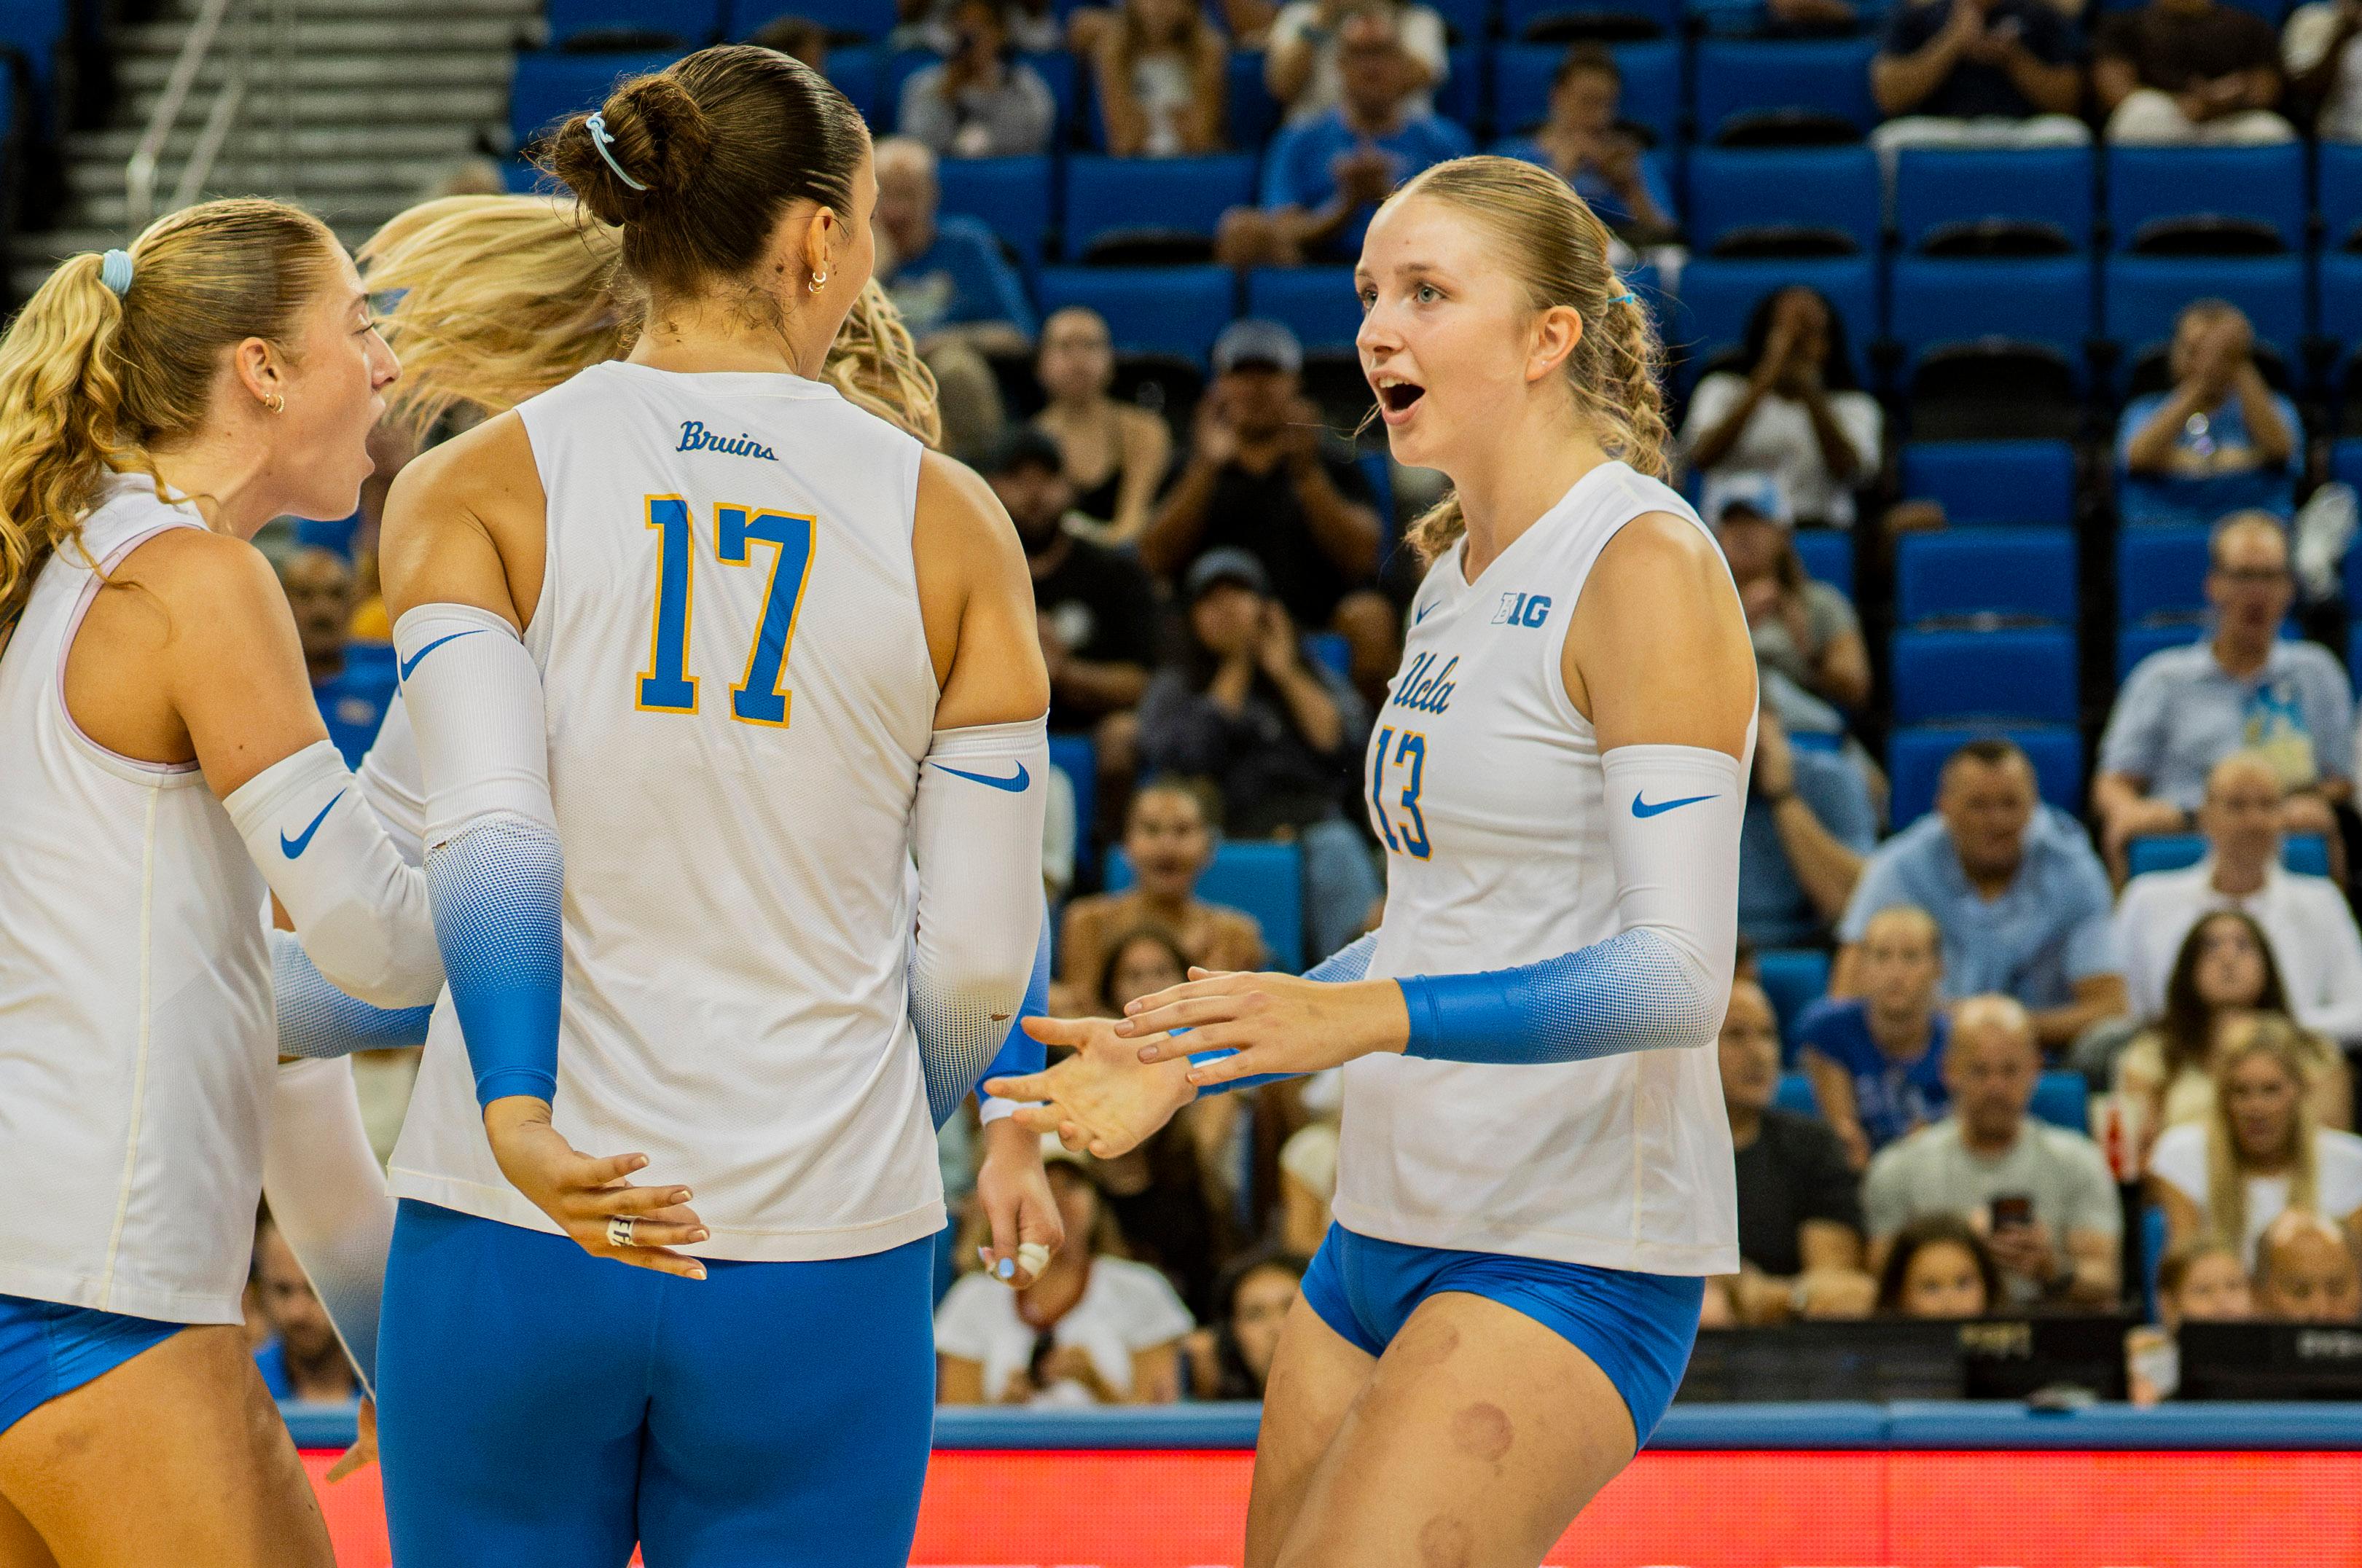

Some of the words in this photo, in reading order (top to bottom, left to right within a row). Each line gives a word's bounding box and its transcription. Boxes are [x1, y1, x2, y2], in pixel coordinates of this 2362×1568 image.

[676, 420, 778, 460] Bruins
[635, 493, 816, 729] 17
[1373, 725, 1433, 861] 13
